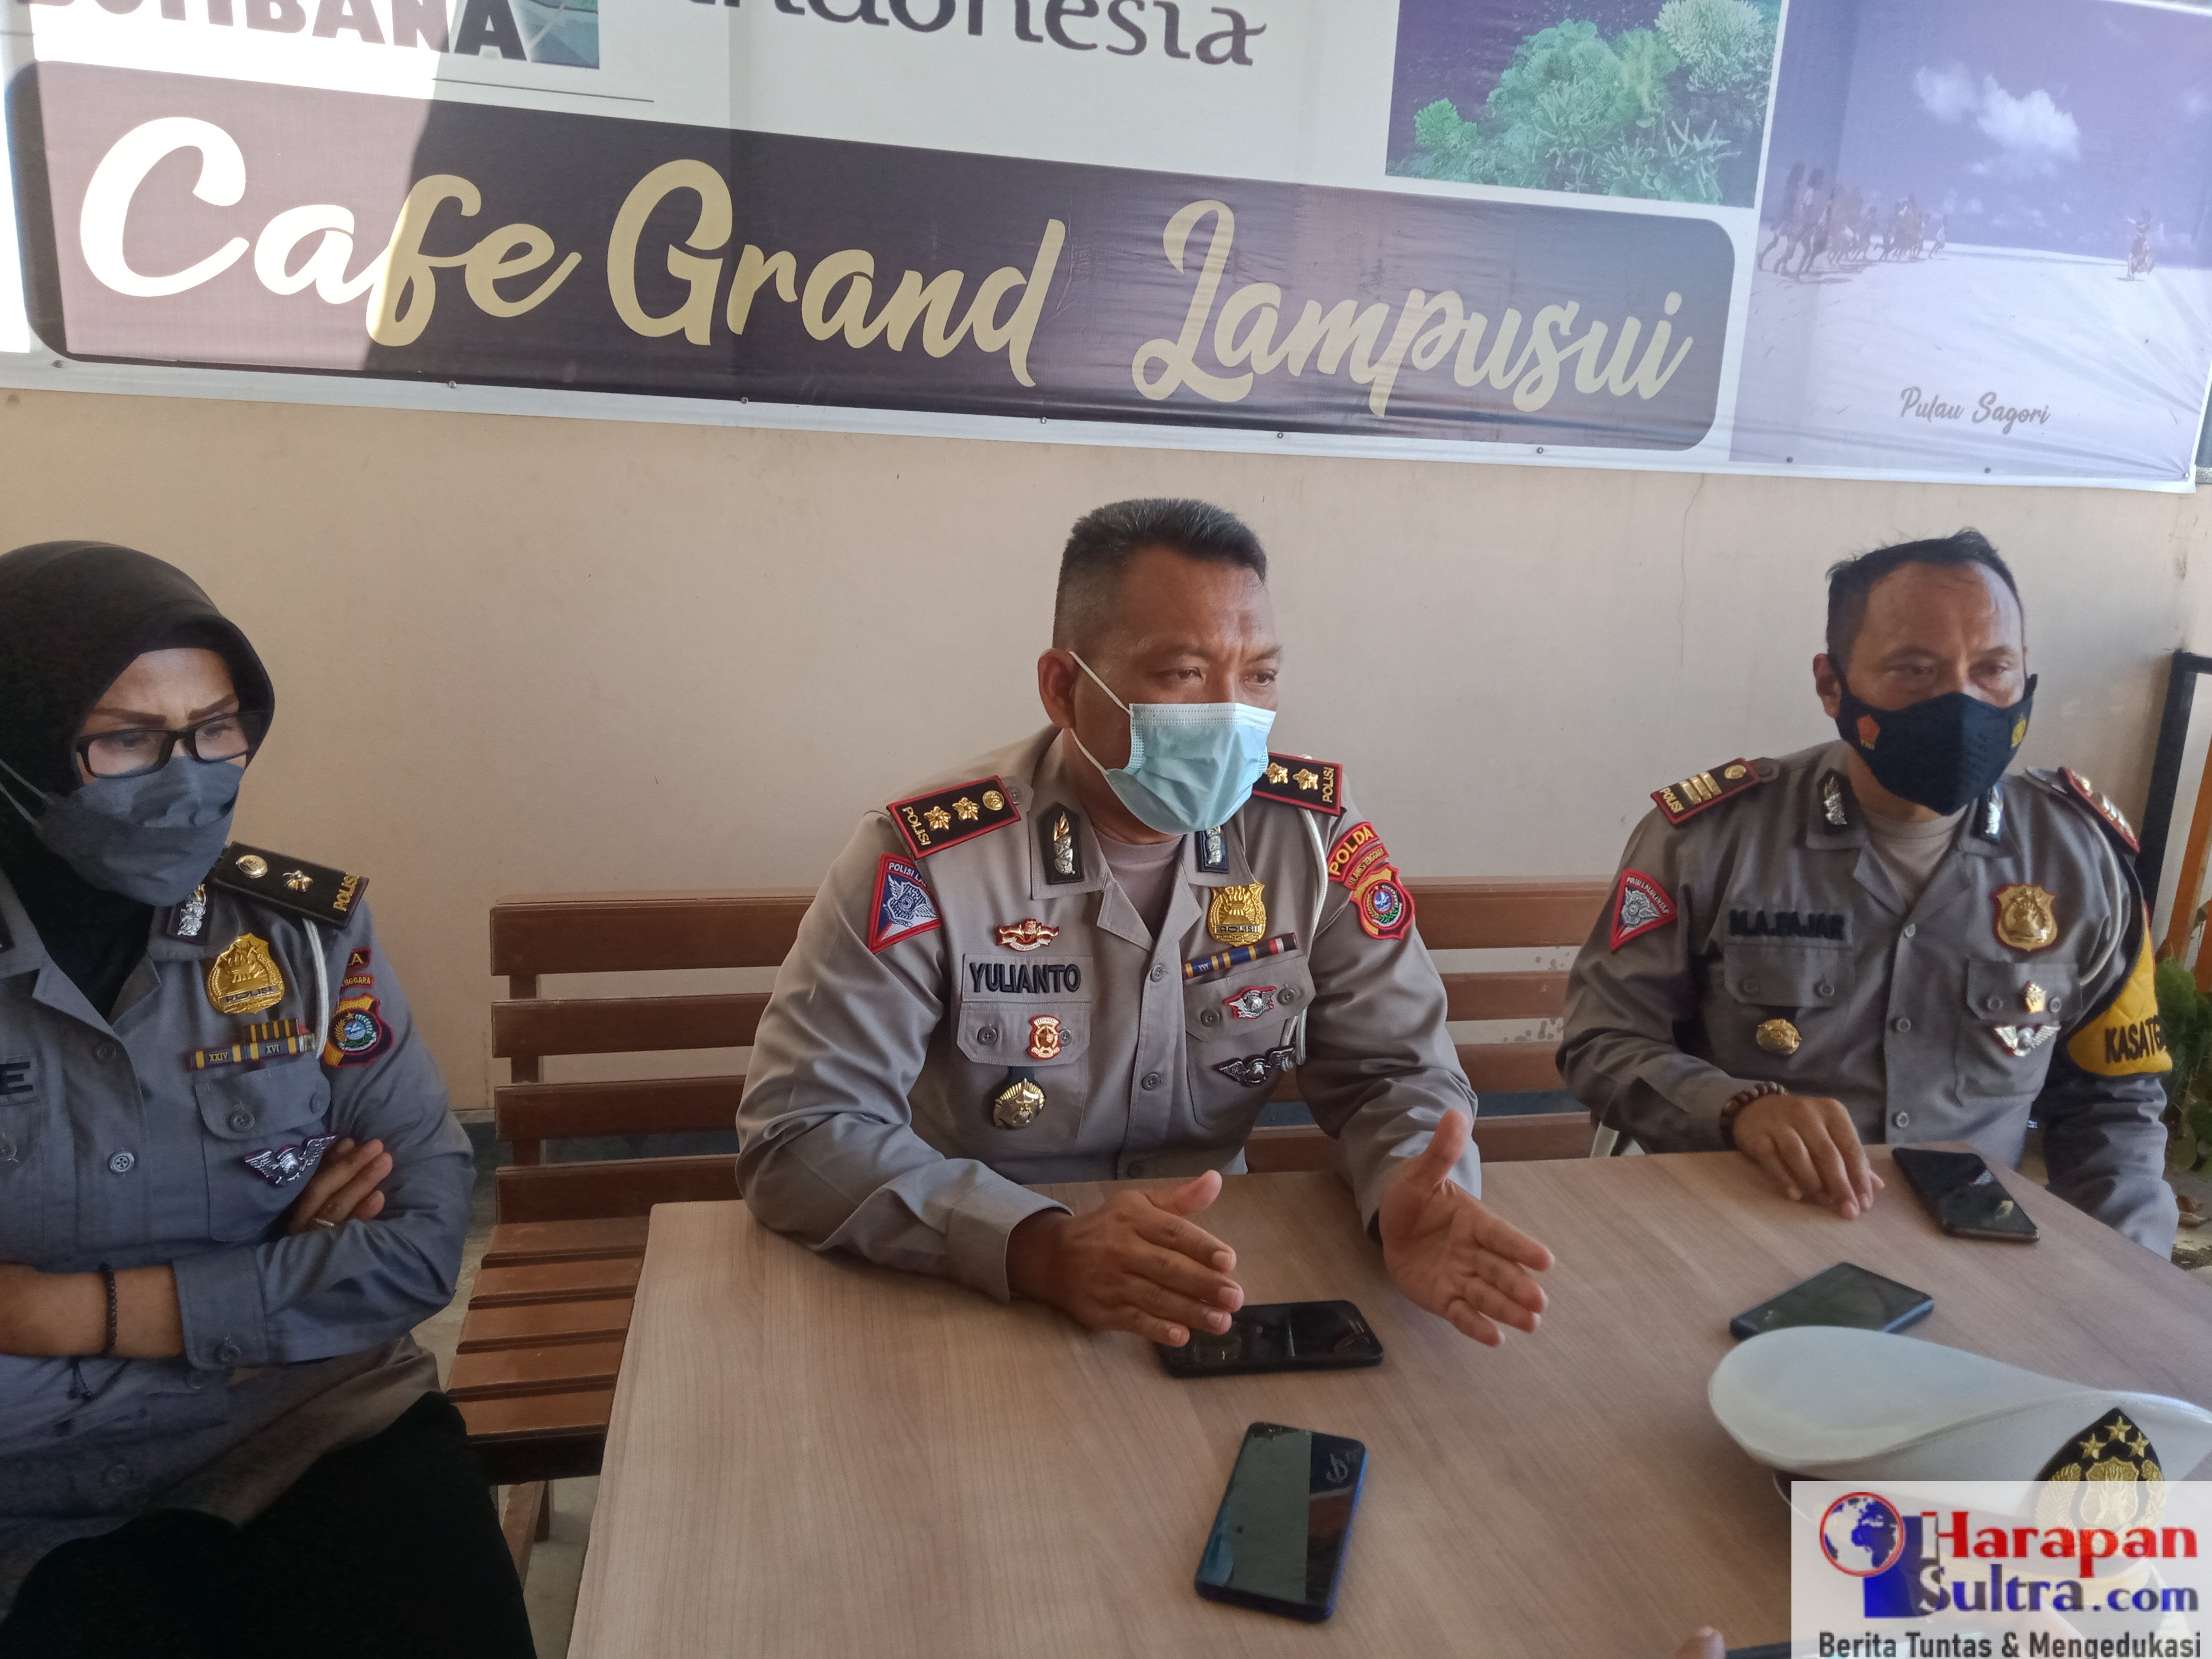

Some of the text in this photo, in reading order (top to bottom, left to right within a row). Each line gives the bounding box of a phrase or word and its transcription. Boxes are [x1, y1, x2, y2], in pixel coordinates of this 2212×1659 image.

[80, 116, 1694, 419] Cafe Grand Lampusui
[1900, 386, 2051, 435] Pulau Sagori
[1322, 766, 1335, 803] POLISI
[1659, 787, 1685, 814] POLISI
[902, 806, 932, 845] POLISI
[1329, 826, 1374, 876] POLDA
[888, 862, 915, 877] POLISI
[332, 872, 359, 912] POLISI
[225, 986, 273, 1003] POLISI
[342, 976, 371, 987] NGGARA
[969, 962, 1082, 993] YULIANTO
[209, 1044, 280, 1062] XXIV XVI
